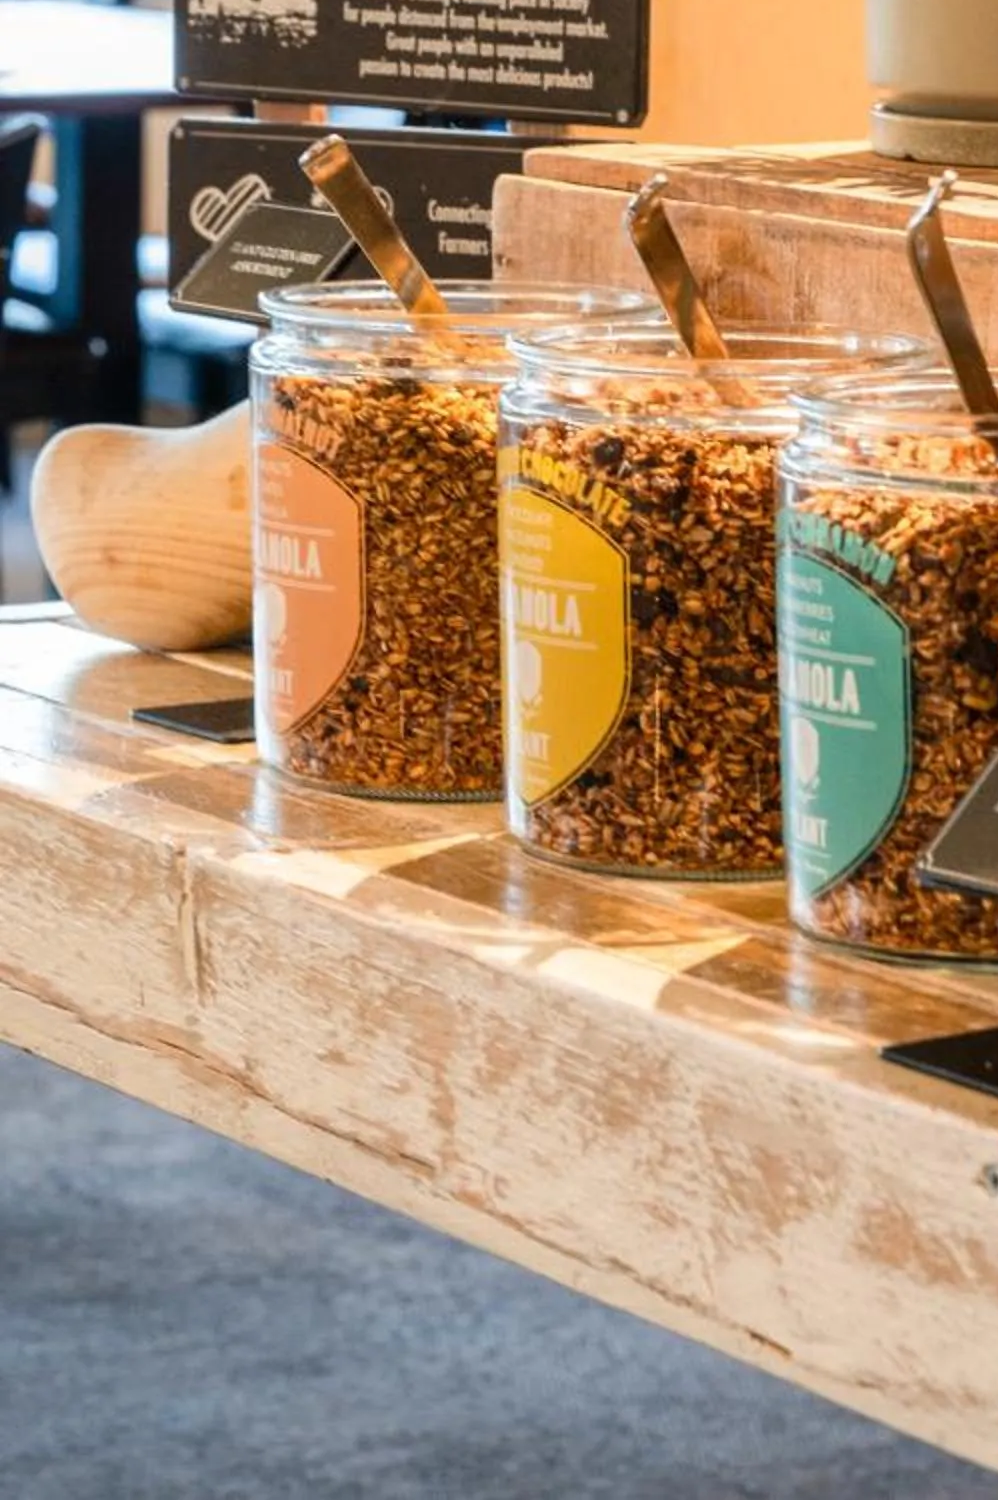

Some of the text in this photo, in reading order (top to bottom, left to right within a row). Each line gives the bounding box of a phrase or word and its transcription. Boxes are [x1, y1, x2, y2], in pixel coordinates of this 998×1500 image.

[521, 447, 631, 526] CHOCOLATE
[260, 531, 322, 579] NOLA
[508, 582, 583, 638] NOLA
[790, 654, 861, 714] NOLA
